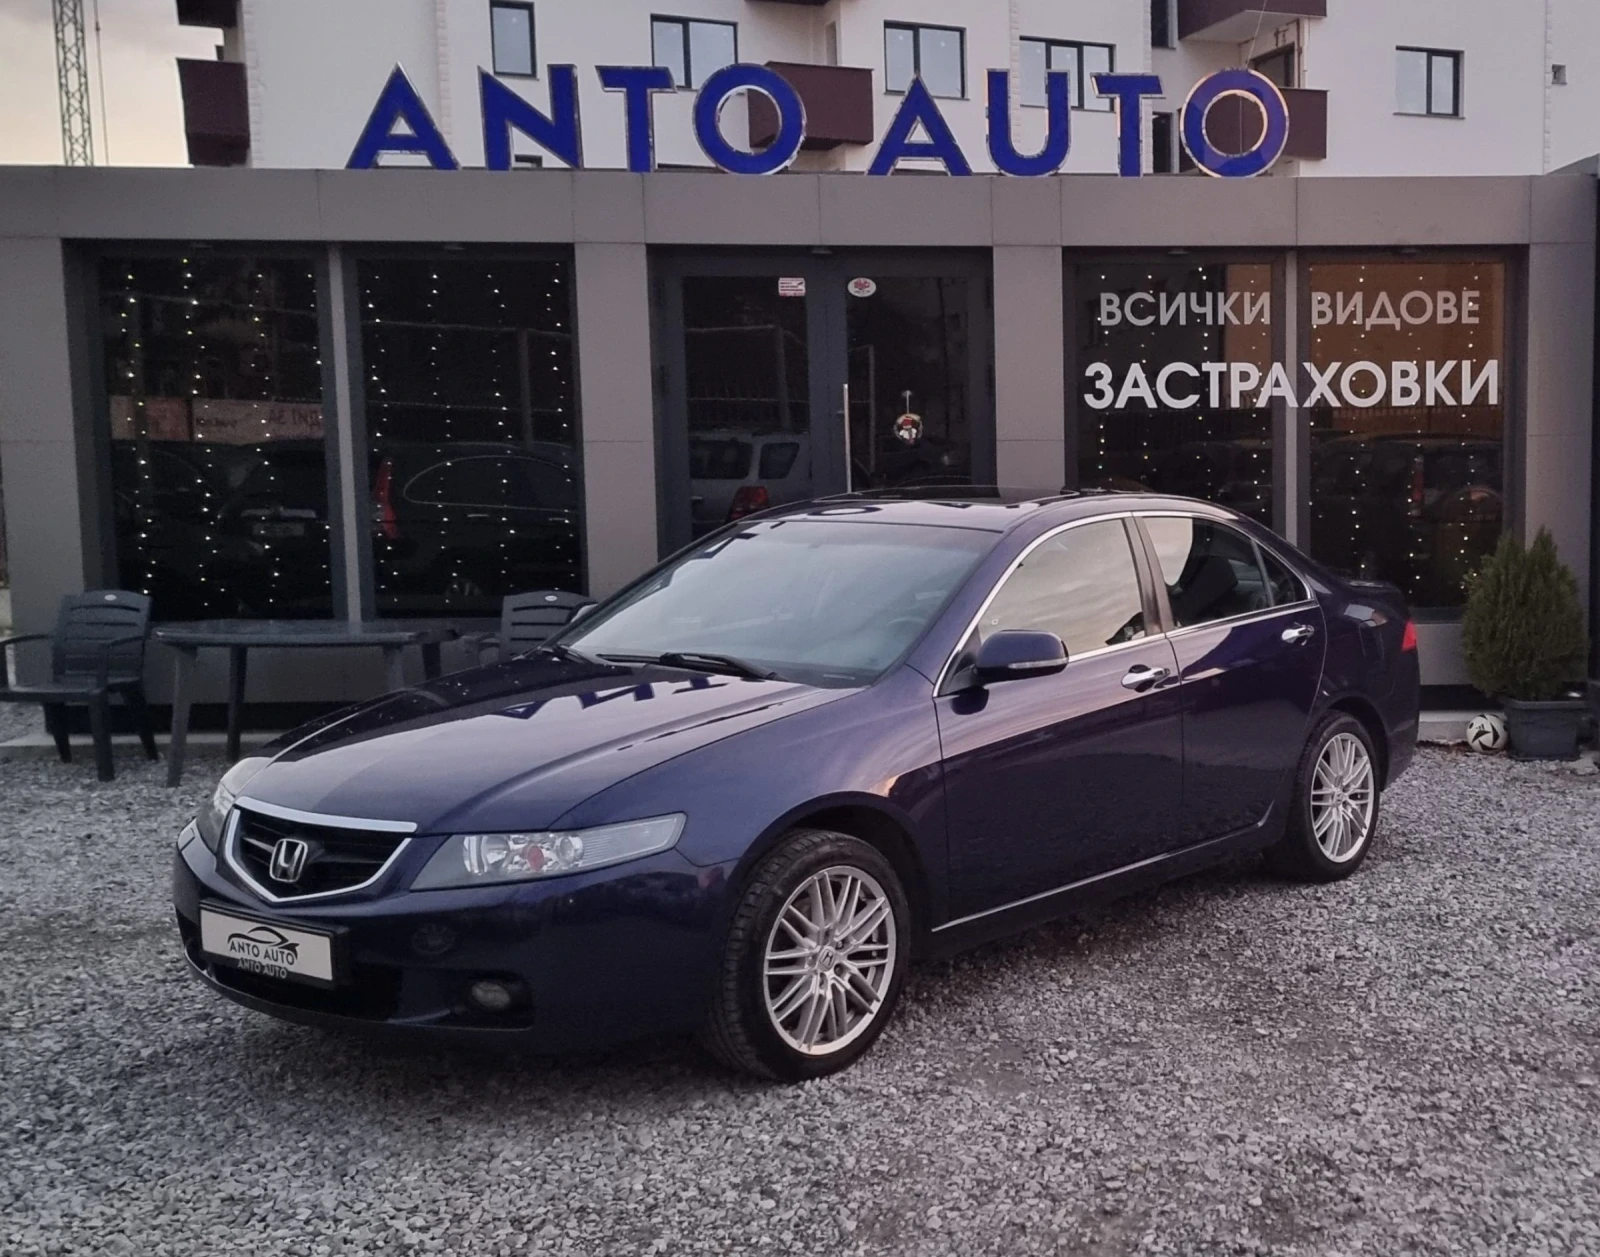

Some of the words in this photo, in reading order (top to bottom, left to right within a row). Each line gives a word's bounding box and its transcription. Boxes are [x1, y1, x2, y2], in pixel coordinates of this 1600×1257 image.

[345, 62, 807, 175] ANTO
[867, 68, 1290, 177] AUTO
[1100, 292, 1271, 326] ВСИЧКИ
[1311, 290, 1481, 331] ВИДОВЕ
[1084, 360, 1499, 409] ЗАСТРАХОВКИ
[230, 942, 260, 957] ANTO
[265, 950, 295, 966] AUTO
[238, 958, 261, 973] ANTO
[263, 965, 287, 979] AUTO
